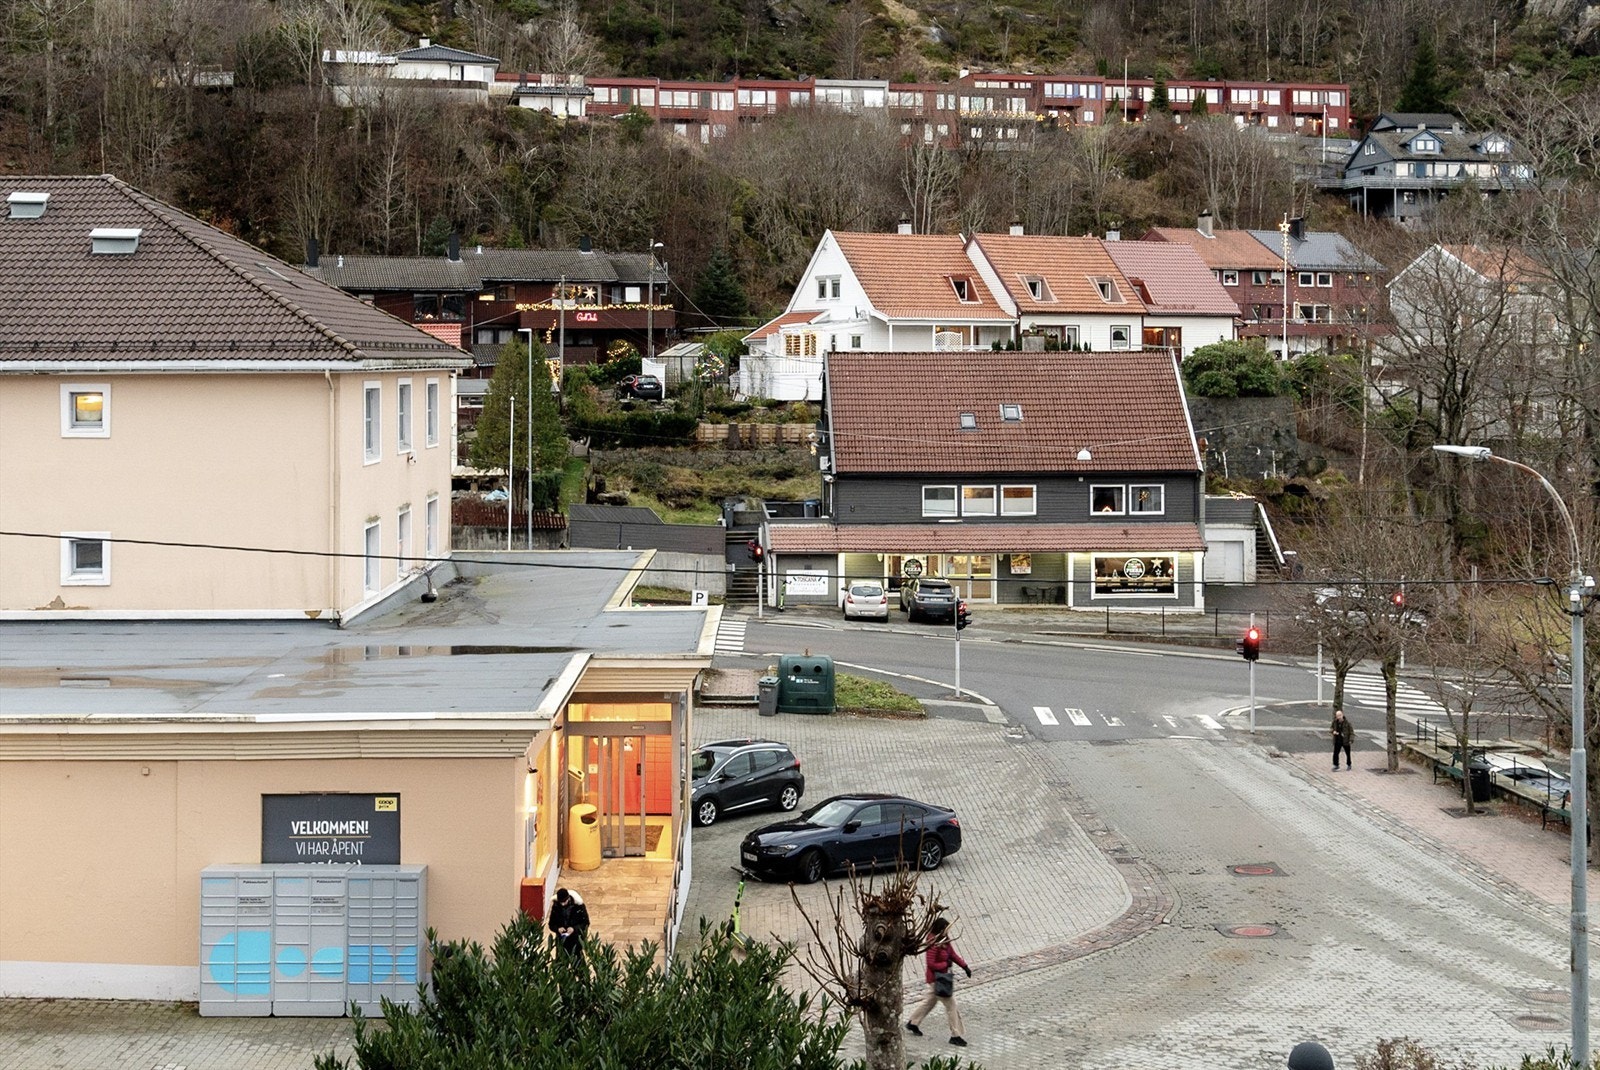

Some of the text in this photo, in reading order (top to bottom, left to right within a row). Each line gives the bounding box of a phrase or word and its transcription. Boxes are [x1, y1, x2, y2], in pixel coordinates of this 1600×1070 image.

[696, 592, 704, 603] P
[291, 820, 369, 835] VELKOMMEN!
[295, 838, 365, 856] VI HAR ÅPENT
